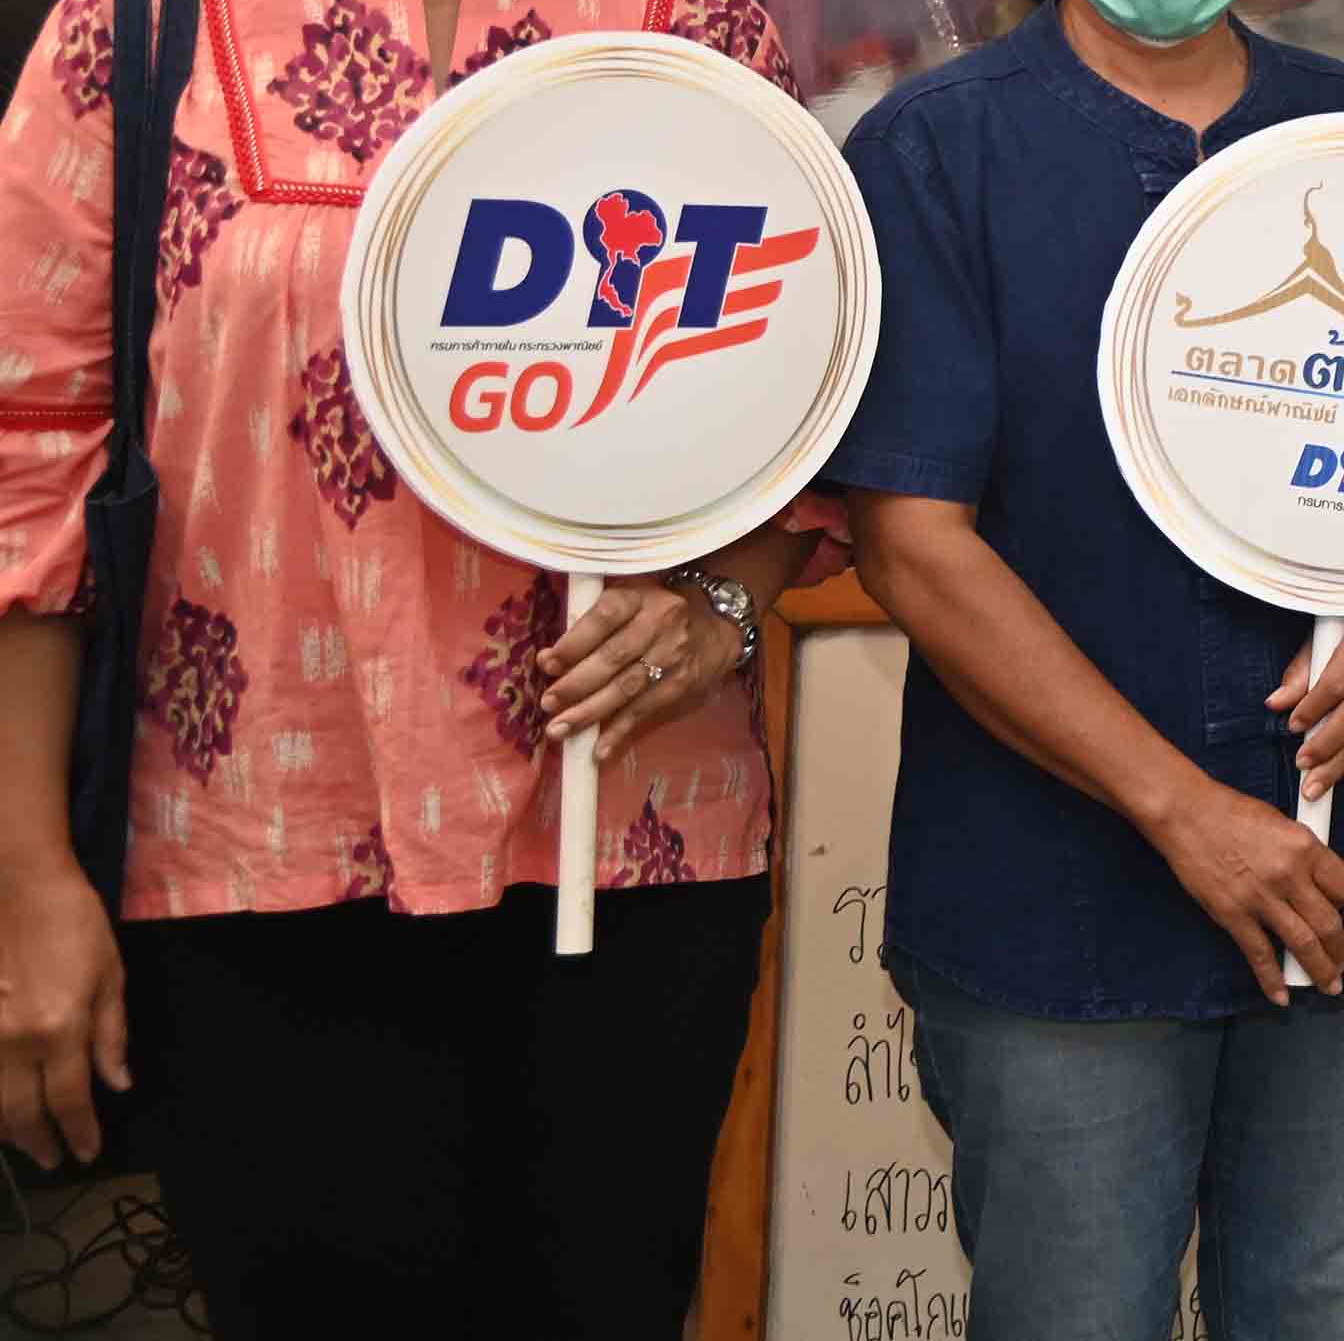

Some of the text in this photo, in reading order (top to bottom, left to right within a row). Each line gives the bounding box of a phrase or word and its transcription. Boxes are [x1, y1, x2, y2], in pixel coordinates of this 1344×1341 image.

[439, 188, 769, 329] DIT
[430, 339, 516, 352] กรมการค้าภายใน
[448, 361, 574, 434] GO
[846, 1008, 917, 1105] ลำไ
